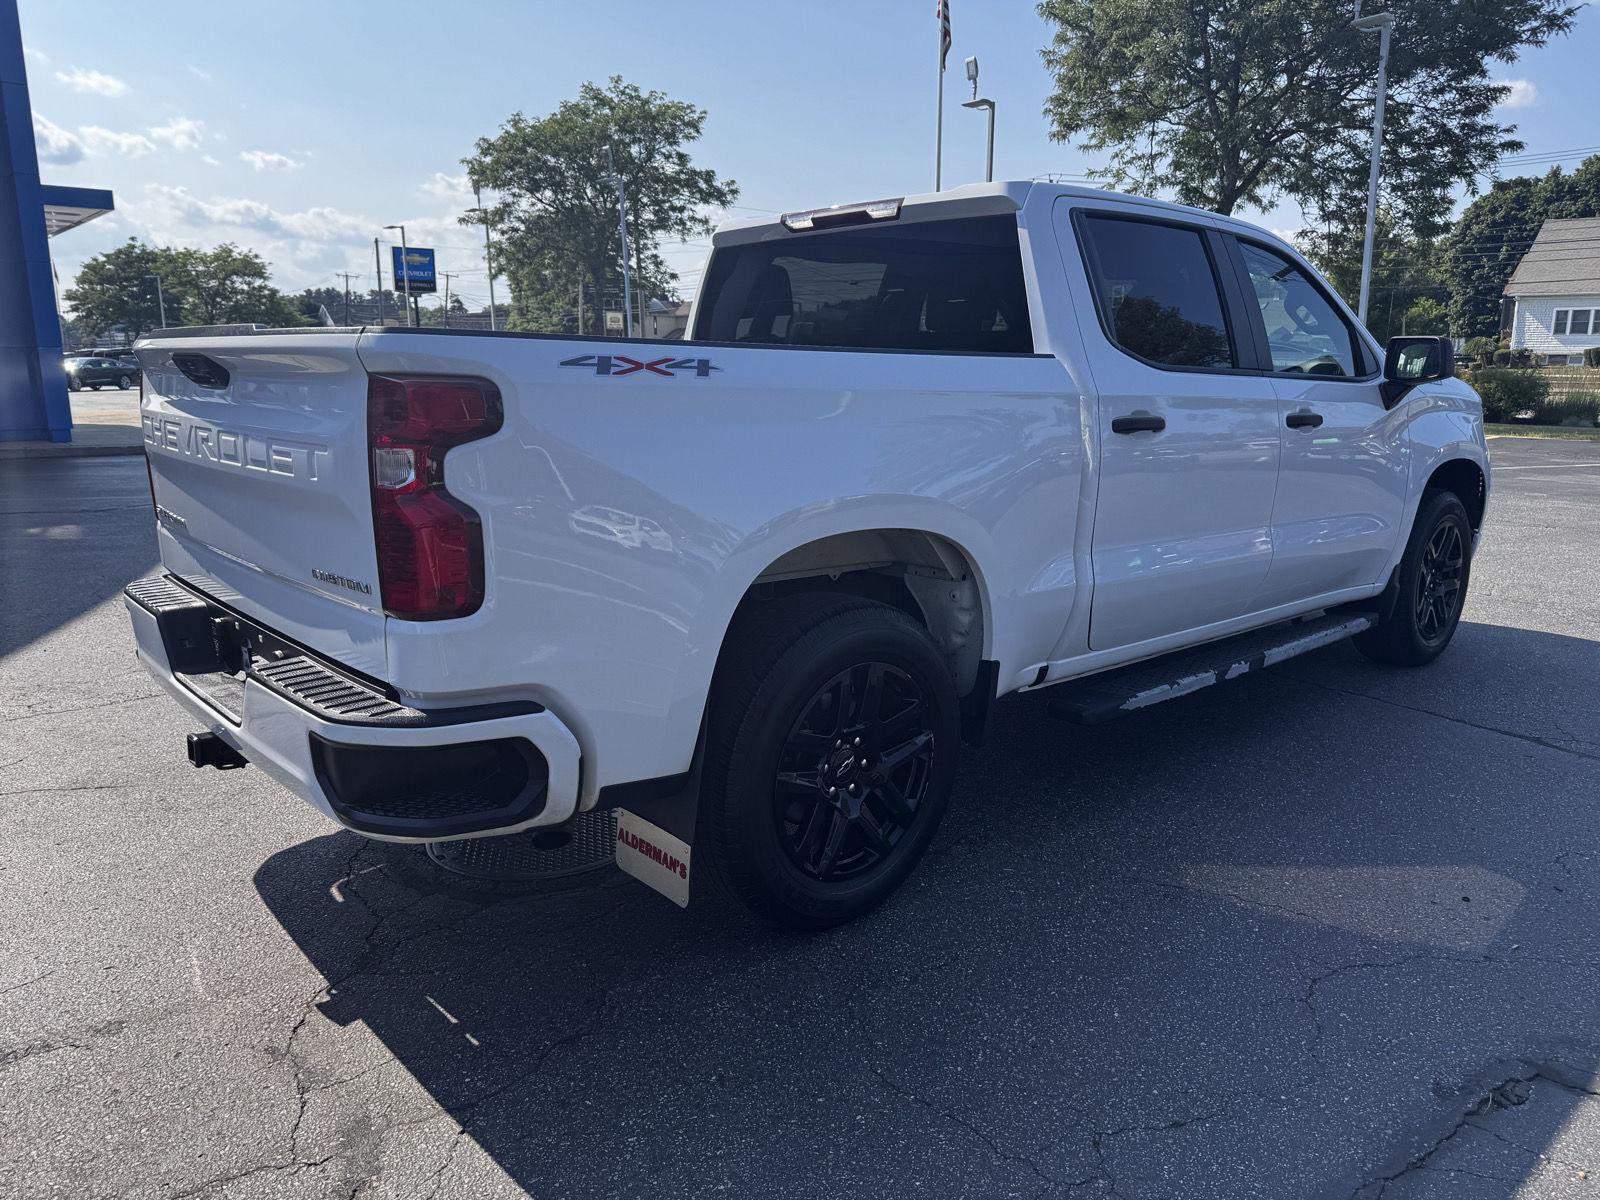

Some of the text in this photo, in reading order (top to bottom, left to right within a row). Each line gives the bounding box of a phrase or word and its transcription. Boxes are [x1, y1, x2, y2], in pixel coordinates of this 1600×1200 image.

[142, 415, 328, 481] CHEVROLET
[311, 567, 373, 595] CUSTOM
[617, 827, 688, 880] ALDERMAN'S
